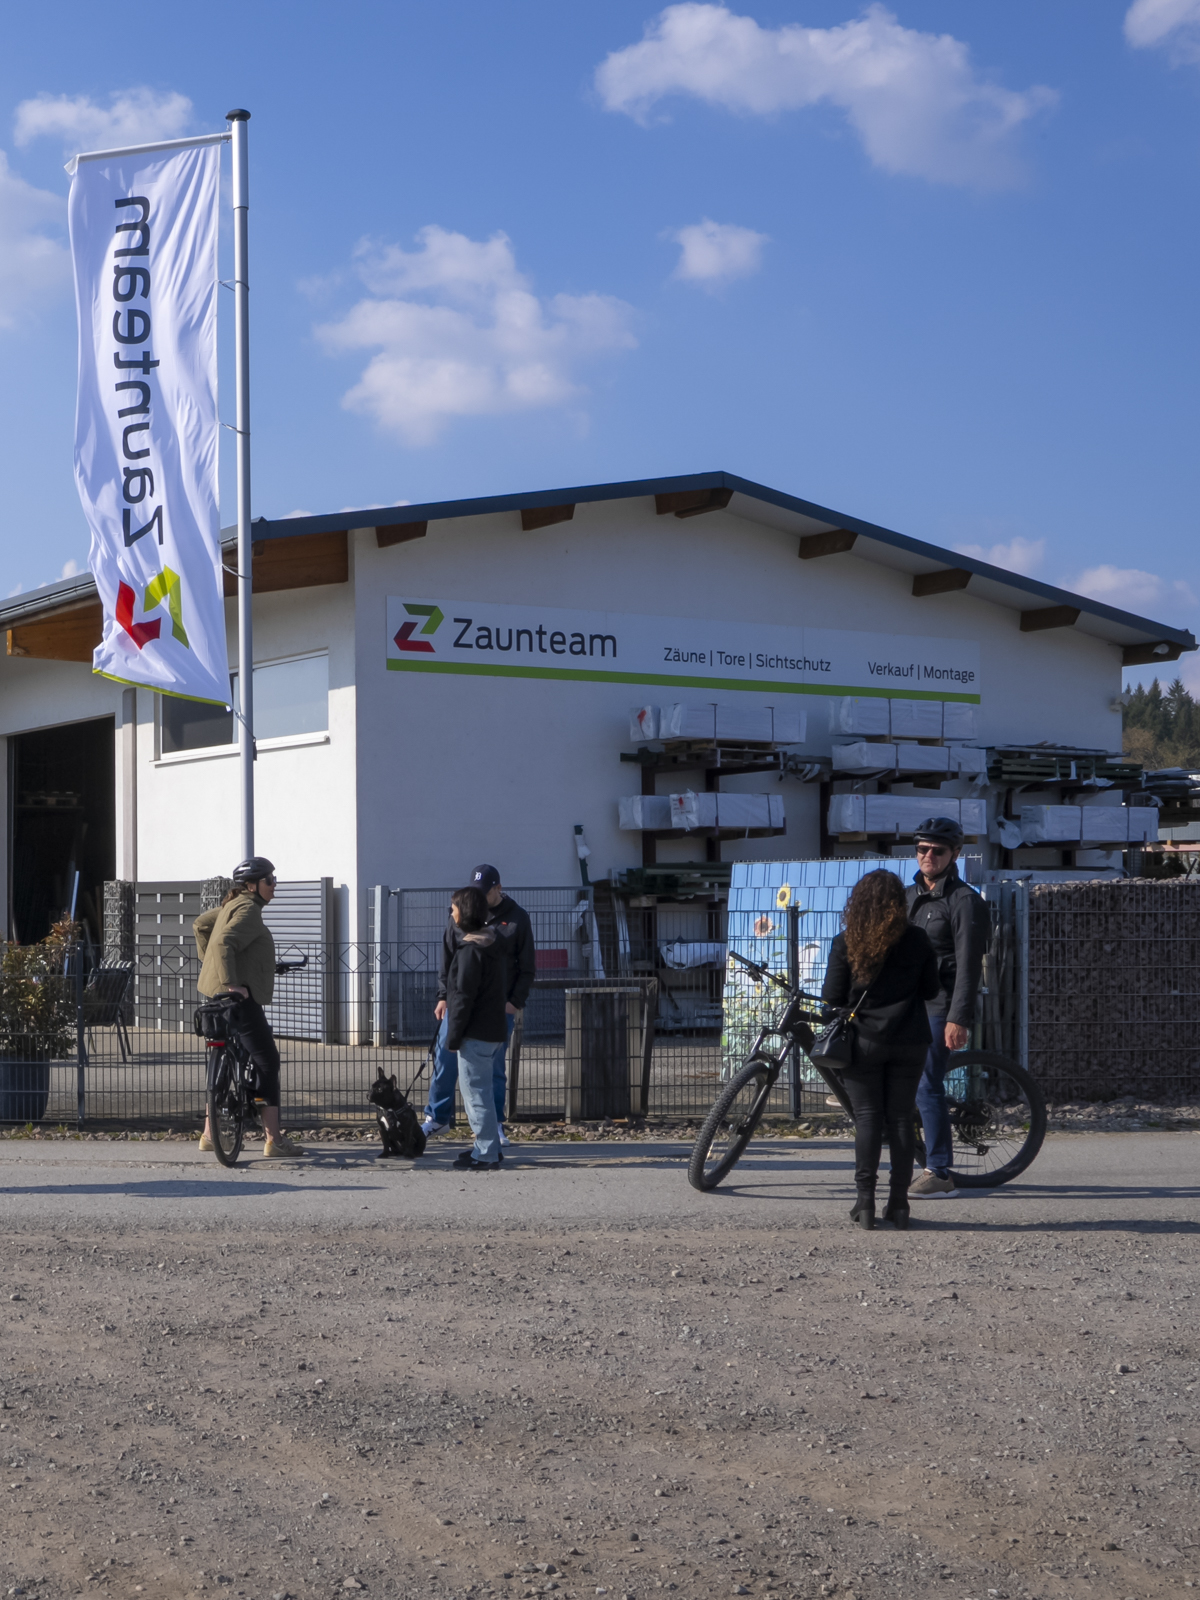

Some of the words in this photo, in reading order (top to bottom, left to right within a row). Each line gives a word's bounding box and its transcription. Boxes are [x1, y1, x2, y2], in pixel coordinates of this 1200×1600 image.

[453, 617, 618, 658] Zaunteam
[663, 647, 706, 664] Zäune
[716, 651, 745, 667] Tore
[755, 653, 832, 672] Sichtschutz
[867, 661, 914, 678] Verkauf
[923, 665, 975, 684] Montage
